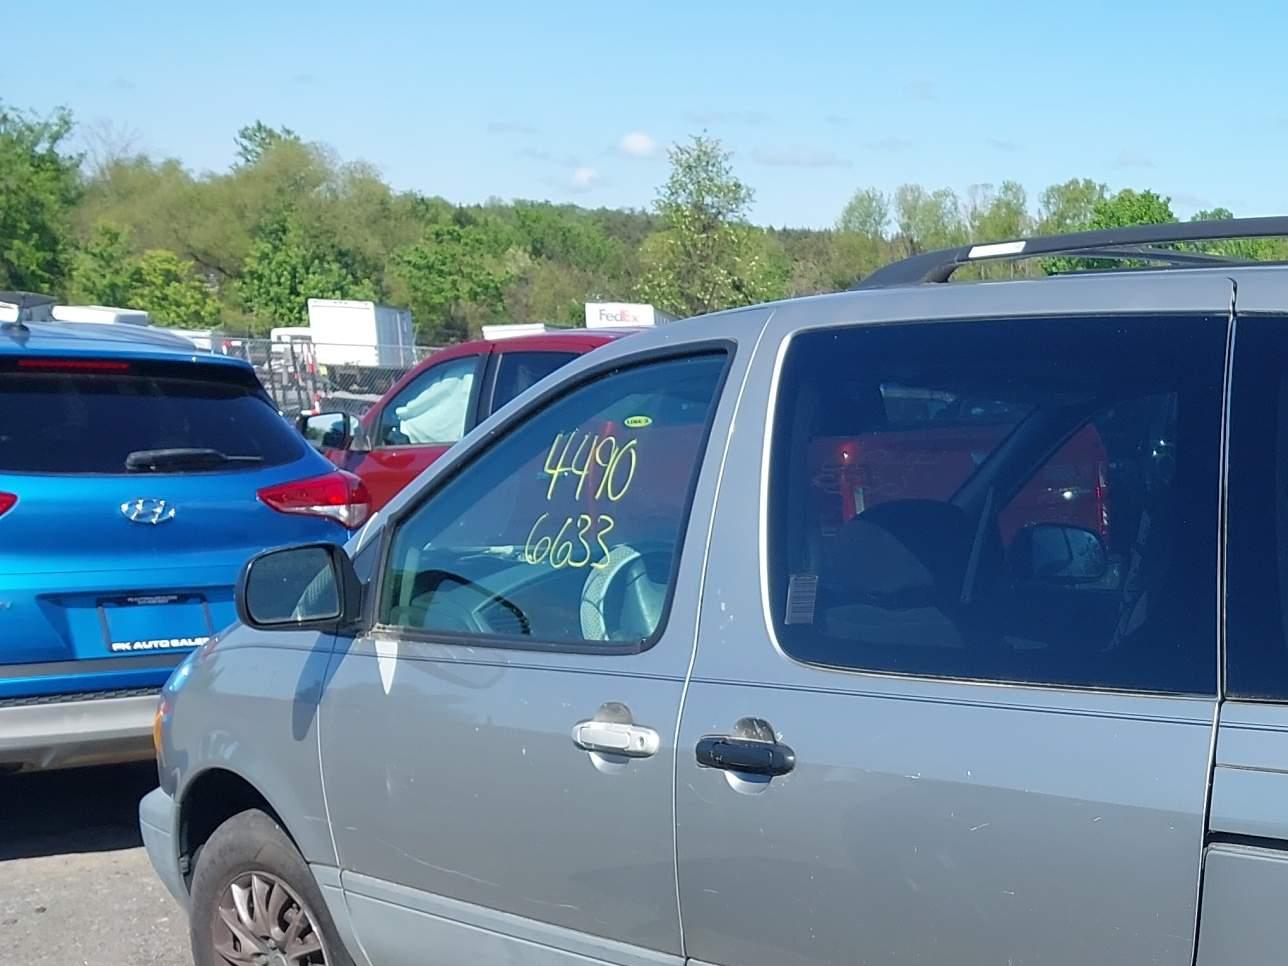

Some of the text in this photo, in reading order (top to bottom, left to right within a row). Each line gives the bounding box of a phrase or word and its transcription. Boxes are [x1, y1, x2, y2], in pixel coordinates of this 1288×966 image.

[599, 309, 640, 322] FedEx
[543, 428, 638, 501] 4490
[525, 512, 614, 569] 6633
[133, 639, 170, 650] AUTO
